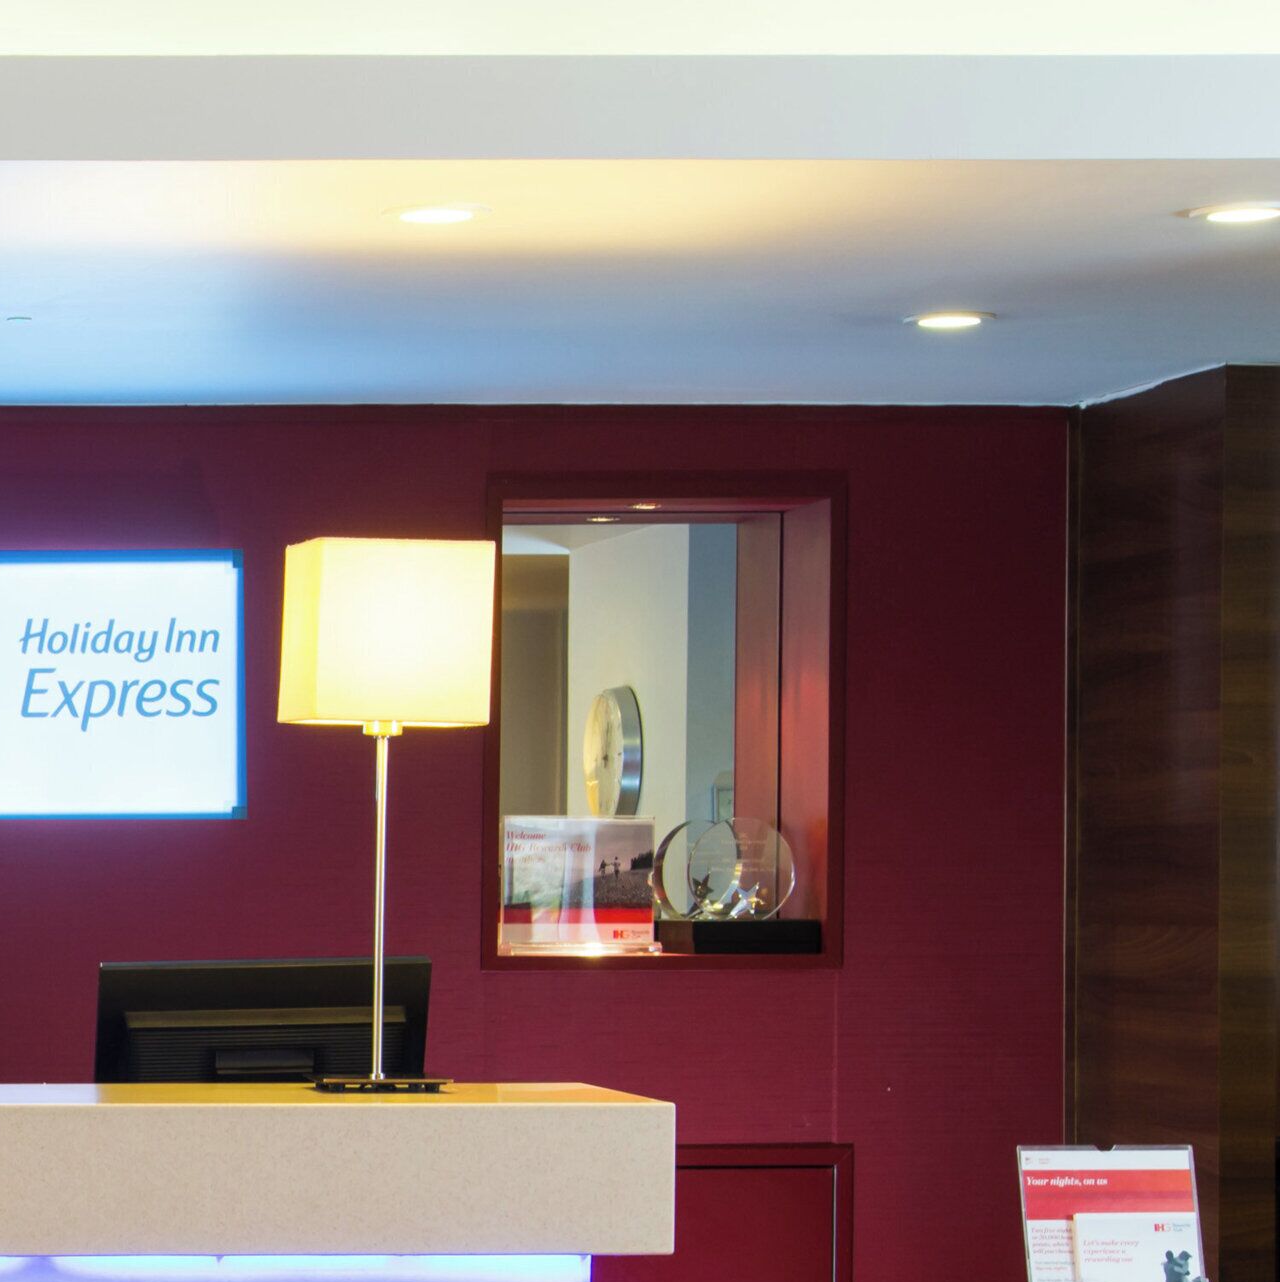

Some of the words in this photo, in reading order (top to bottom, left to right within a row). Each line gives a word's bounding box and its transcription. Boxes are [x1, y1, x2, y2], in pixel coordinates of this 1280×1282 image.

[19, 617, 159, 663] Holiday
[164, 617, 221, 654] Inn
[19, 667, 221, 732] Express
[506, 831, 547, 841] Welcome
[1026, 1175, 1050, 1187] Your
[1050, 1175, 1083, 1189] nights,
[1083, 1178, 1095, 1186] on
[1096, 1177, 1109, 1186] us
